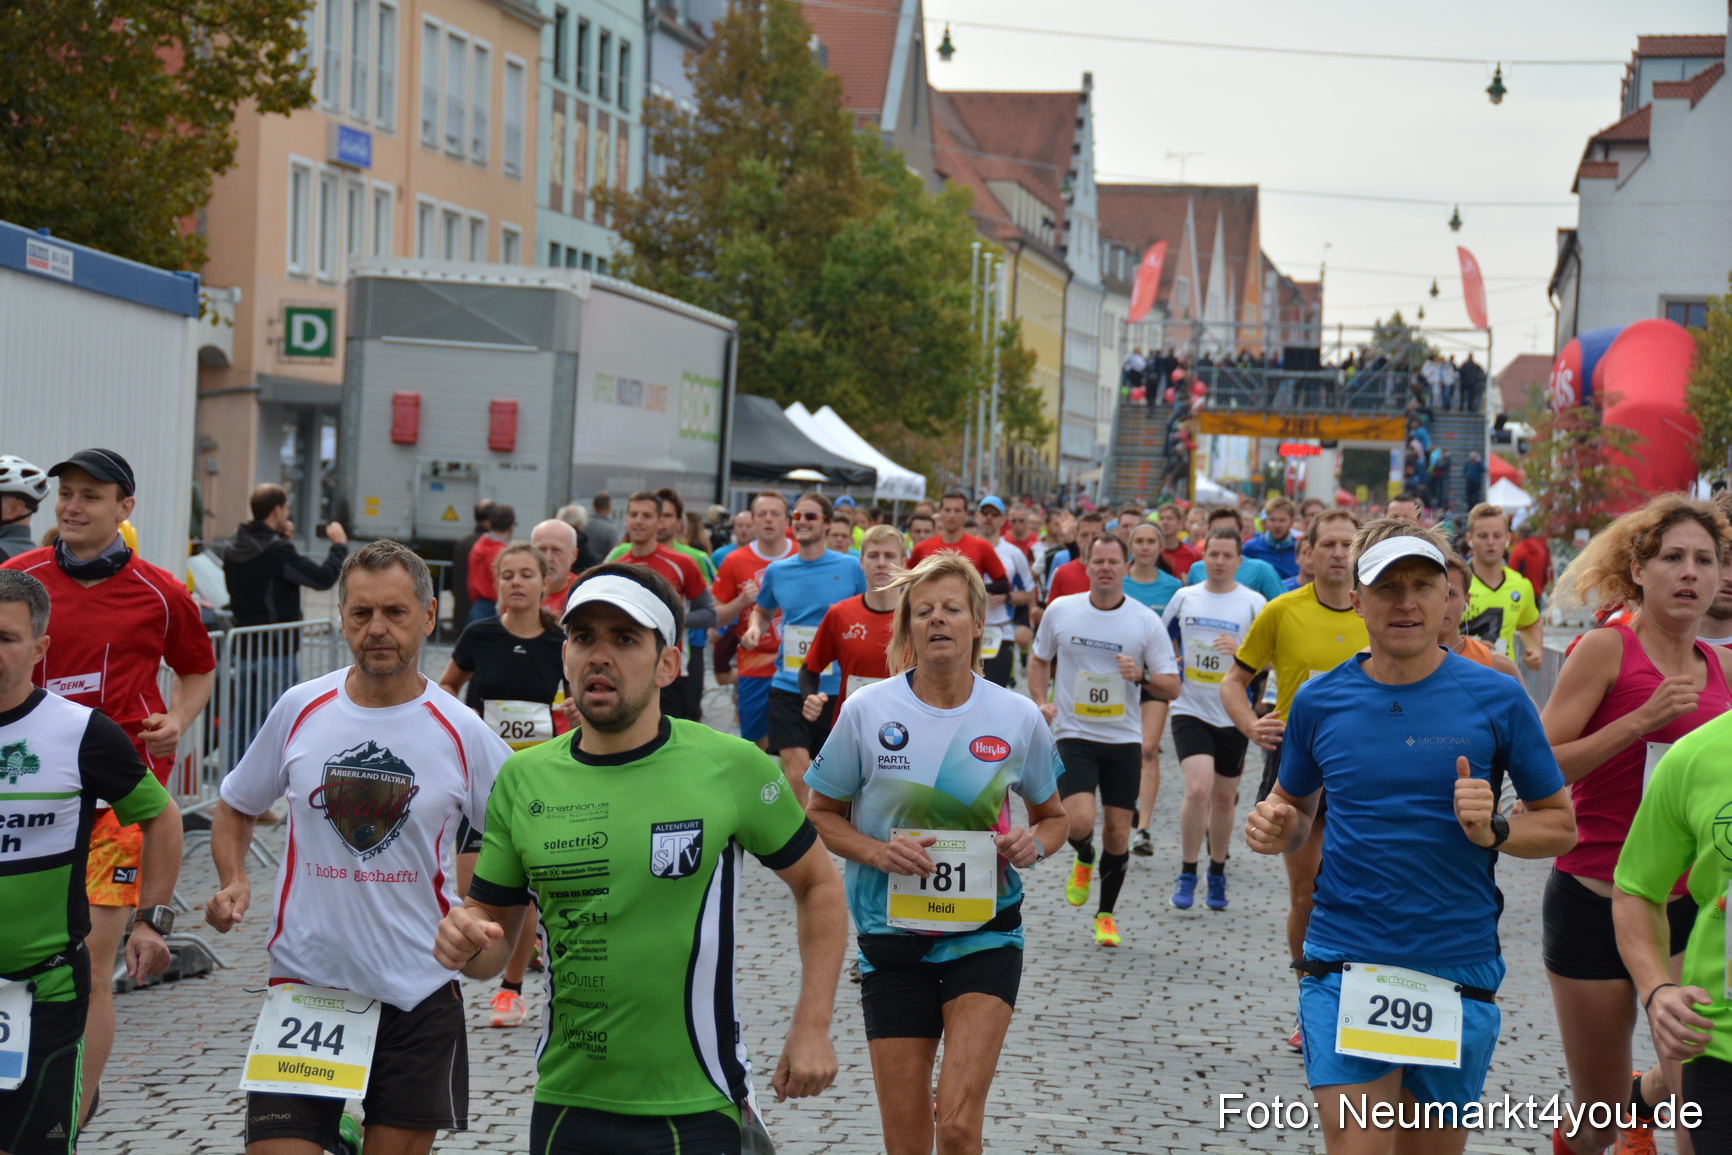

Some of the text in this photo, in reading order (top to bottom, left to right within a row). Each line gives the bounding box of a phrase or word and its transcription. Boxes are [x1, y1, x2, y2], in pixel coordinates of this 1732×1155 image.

[291, 313, 329, 352] D
[1195, 654, 1220, 670] 146
[60, 680, 85, 691] DEHN
[1089, 687, 1109, 703] 60
[499, 720, 536, 739] 262
[1418, 736, 1471, 745] MICRONAS
[975, 741, 1007, 756] Hervis
[877, 755, 911, 765] PARTL
[330, 768, 407, 786] ARBERLAND ULTRA
[546, 801, 610, 812] triathlon.de
[655, 821, 700, 832] ALTENFURT
[543, 834, 600, 850] solectrix
[306, 862, 419, 883] I hobs gschafft!
[927, 901, 956, 914] Heidi
[303, 995, 346, 1009] BOCK
[1367, 994, 1433, 1033] 299
[277, 1016, 346, 1056] 244
[569, 1029, 608, 1043] PHYSIO
[567, 1040, 608, 1054] ZENTRUM
[277, 1061, 335, 1081] Wolfgang
